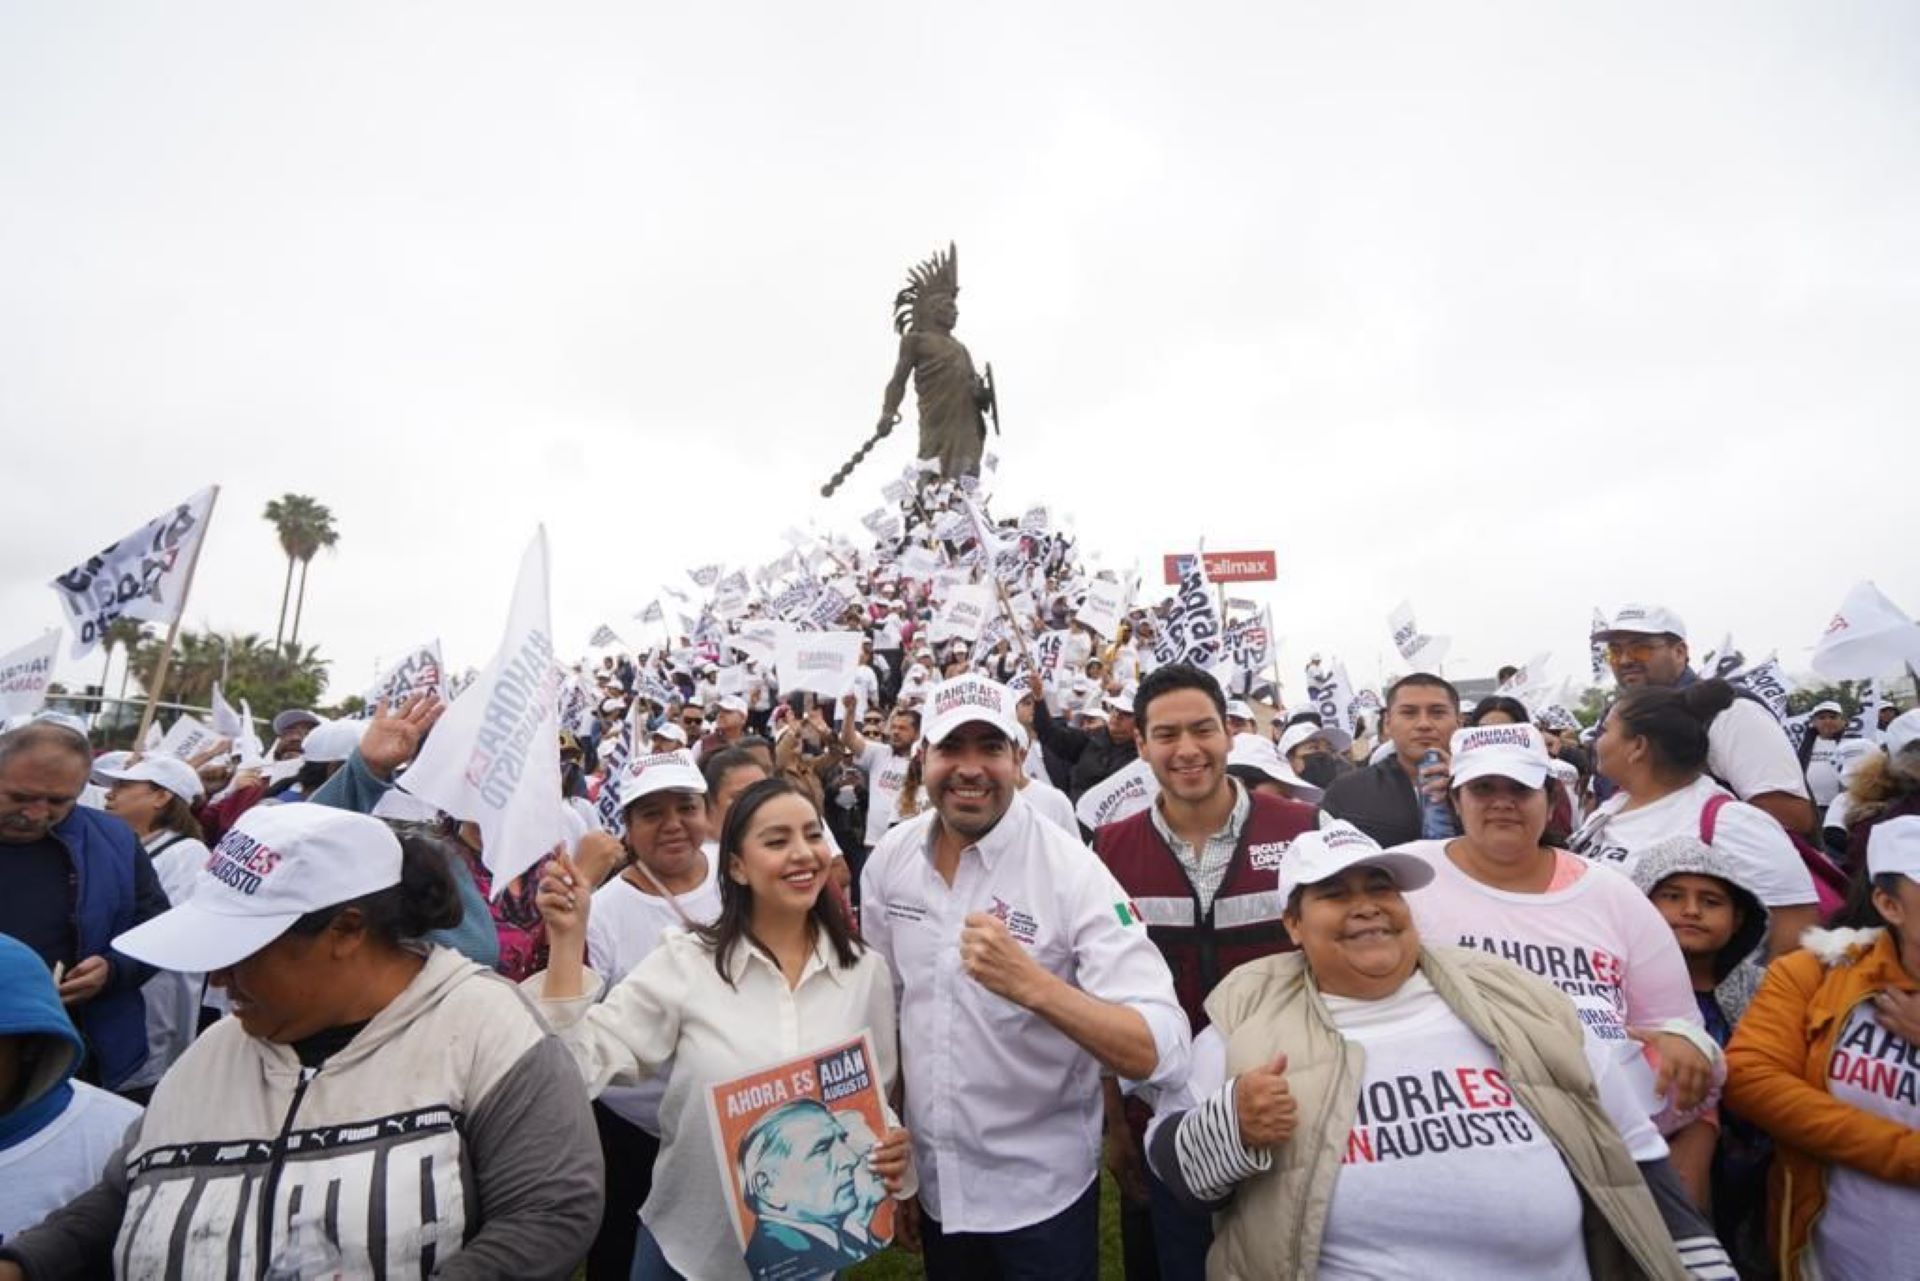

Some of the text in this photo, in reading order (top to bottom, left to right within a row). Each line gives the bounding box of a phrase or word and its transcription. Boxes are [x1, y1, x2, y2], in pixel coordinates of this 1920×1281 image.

[727, 1079, 788, 1119] AHORA
[790, 1069, 815, 1095] ES
[822, 1073, 870, 1101] AUGUSTO
